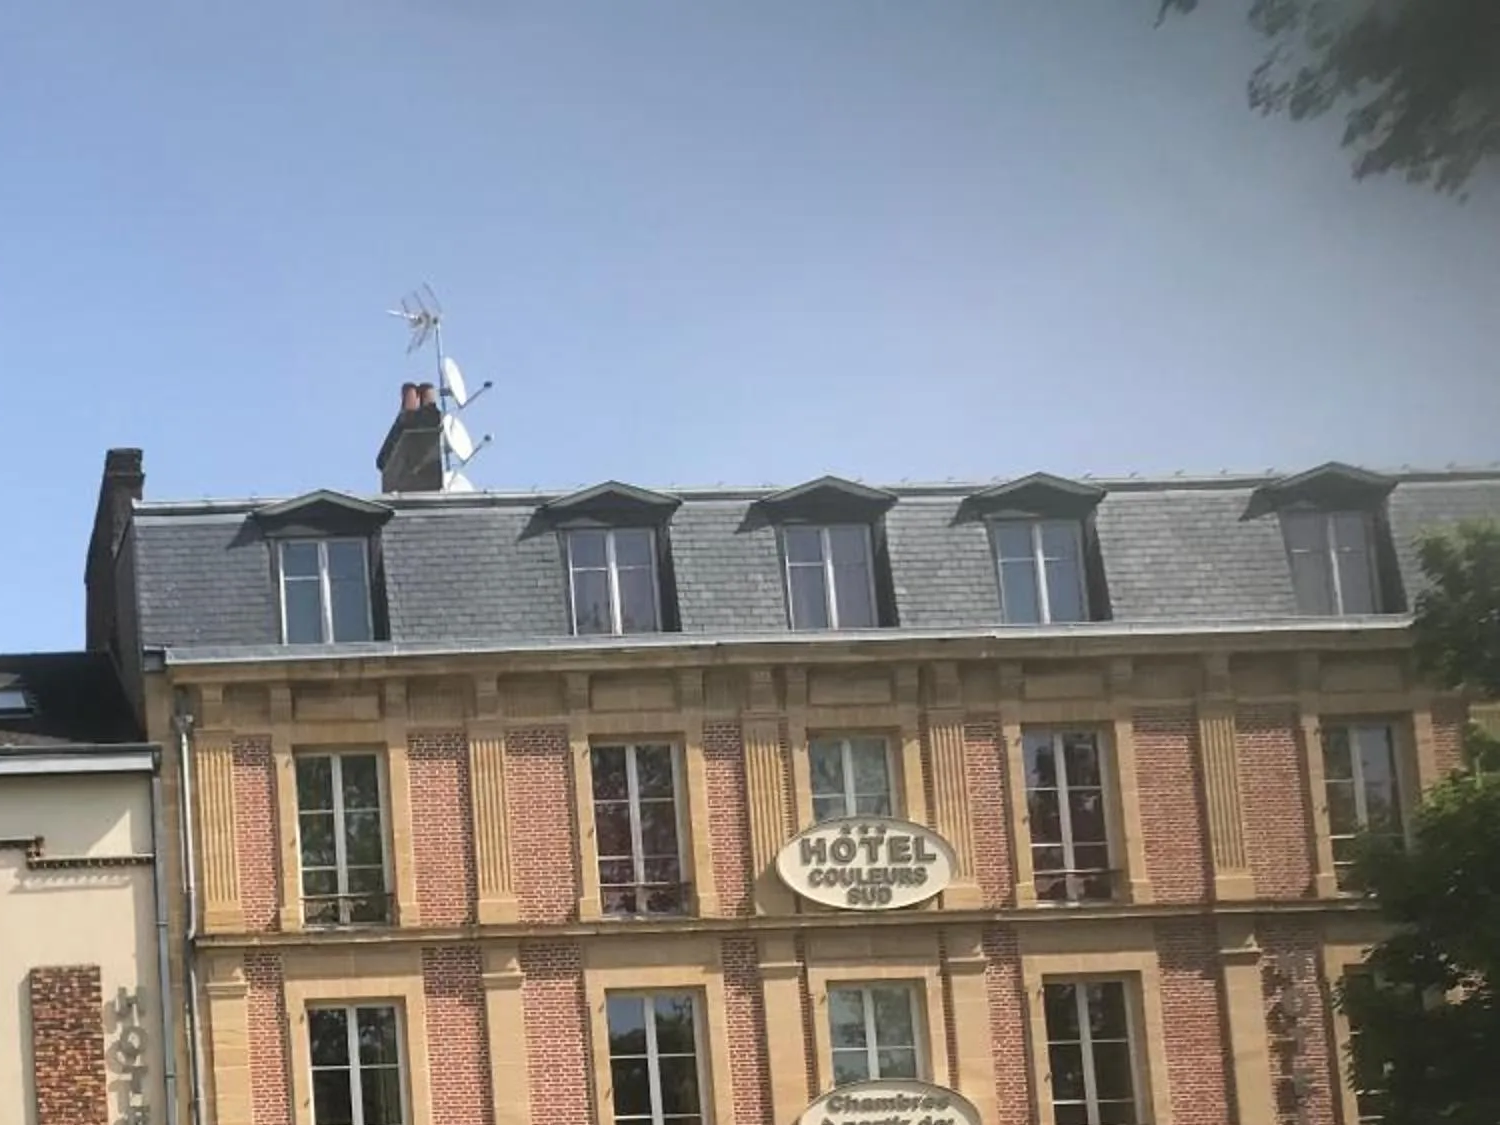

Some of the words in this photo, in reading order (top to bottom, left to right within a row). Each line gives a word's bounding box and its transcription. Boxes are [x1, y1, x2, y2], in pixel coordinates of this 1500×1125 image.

[799, 835, 937, 866] HOTEL
[807, 867, 929, 888] COULEURS
[846, 886, 893, 906] SUD
[825, 1093, 950, 1115] Chambres
